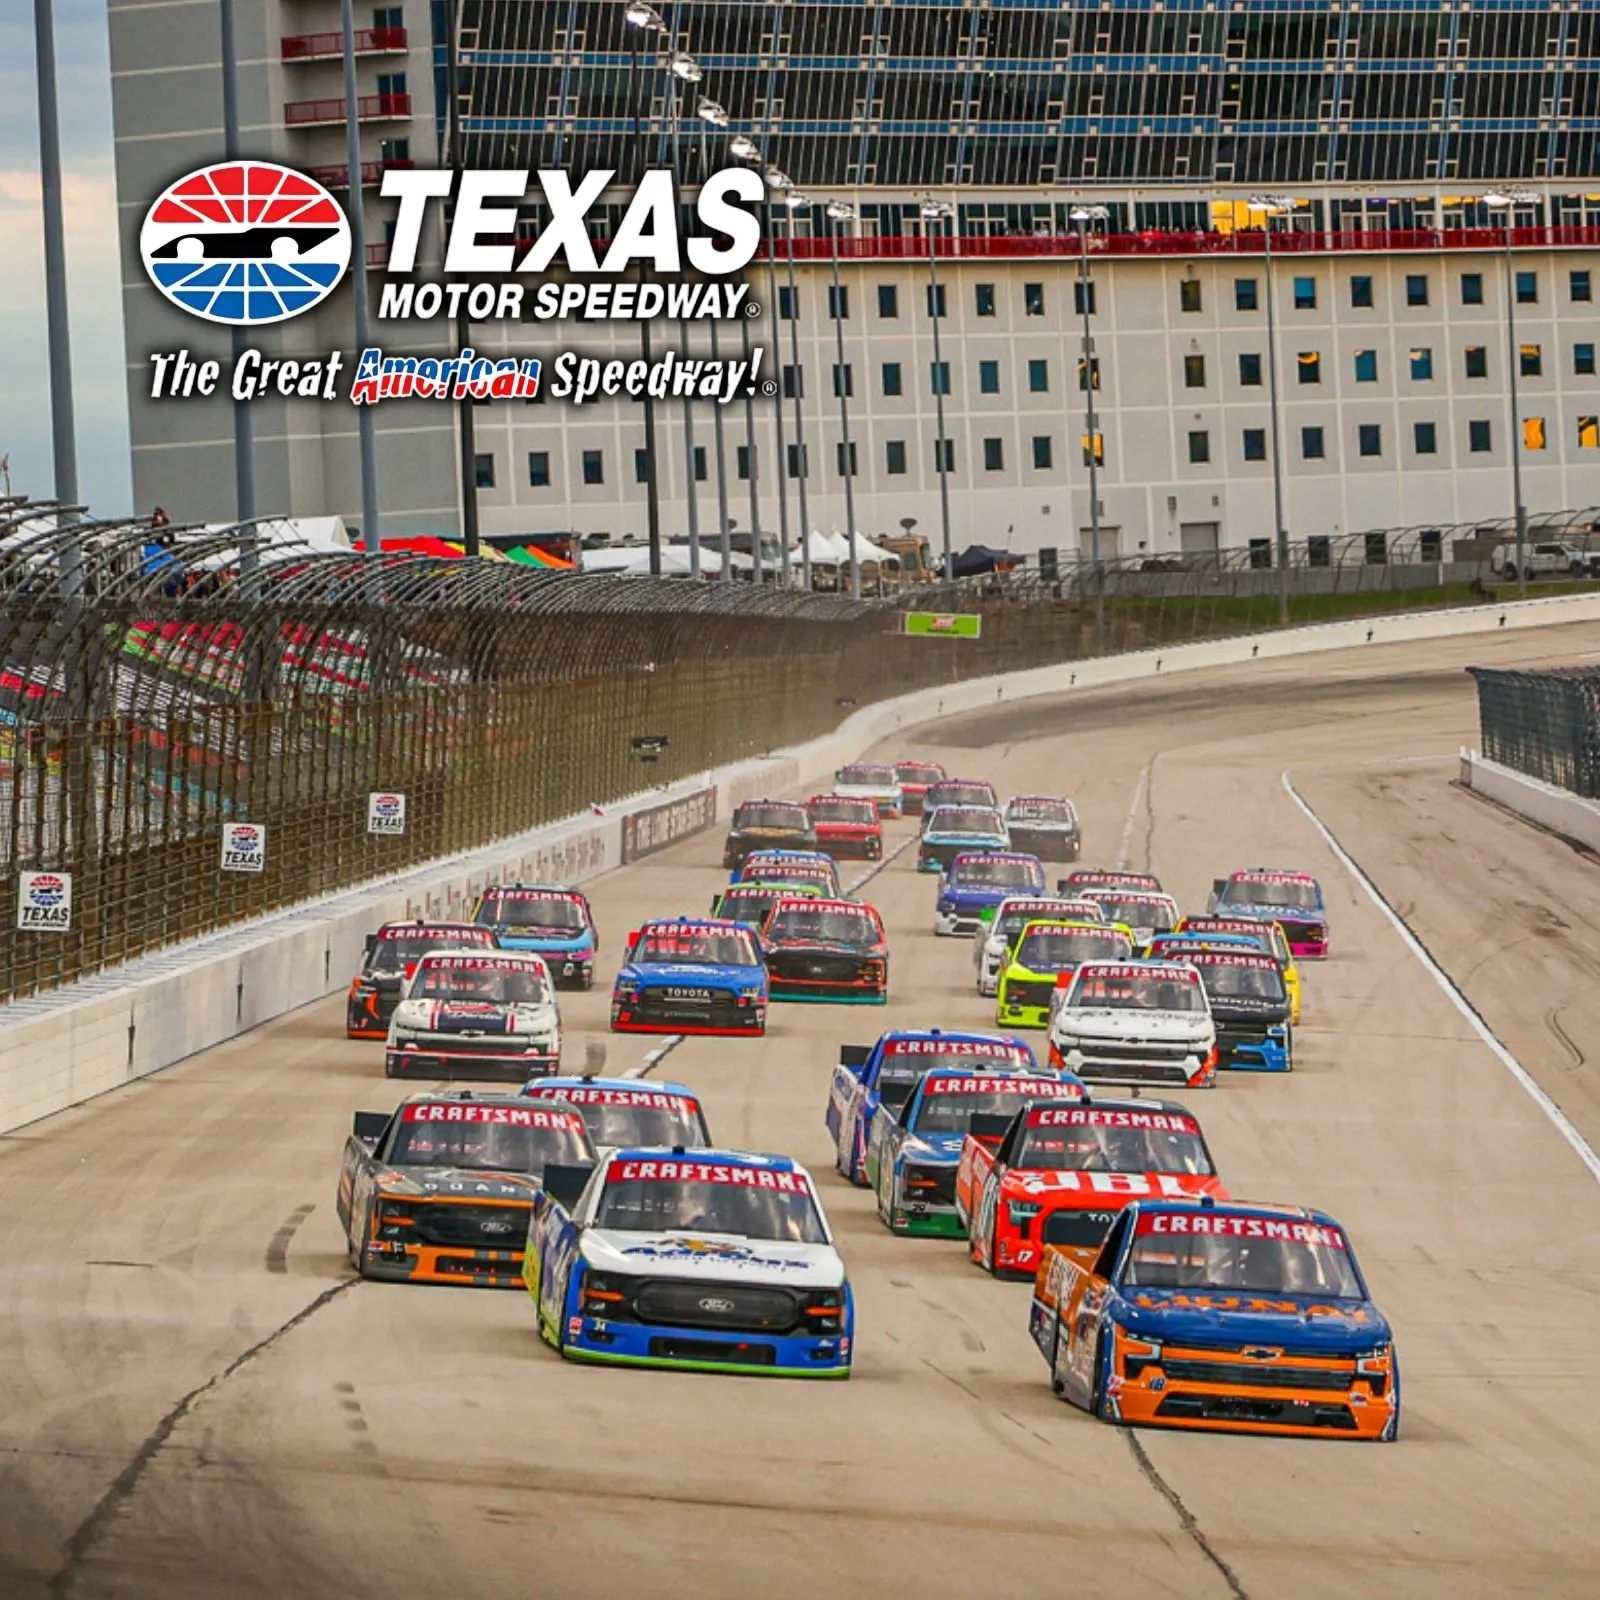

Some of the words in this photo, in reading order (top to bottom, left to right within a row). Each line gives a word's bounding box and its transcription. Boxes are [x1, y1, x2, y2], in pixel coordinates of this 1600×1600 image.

[225, 851, 262, 865] TEXAS
[489, 891, 573, 901] CRAFTSMAN
[23, 907, 69, 922] TEXAS
[781, 903, 867, 917] CRAFTSMAN
[386, 929, 484, 943] CRAFTSMAN
[648, 925, 748, 940] CRAFTSMAN
[431, 958, 535, 973] CRAFTSMAN
[1173, 954, 1272, 969] CRAFTSMAN
[1088, 968, 1190, 982] CRAFTSMAN
[667, 987, 711, 998] TOYOTA
[896, 1041, 1021, 1060] CRAFTSMAN
[934, 1079, 1069, 1097] CRAFTSMAN
[540, 1088, 684, 1110] CRAFTSMAN
[414, 1105, 567, 1131] CRAFTSMAN
[1039, 1111, 1186, 1132] CRAFTSMAN
[622, 1161, 797, 1191] CRAFTSMAN
[1154, 1215, 1334, 1243] CRAFTSMAN
